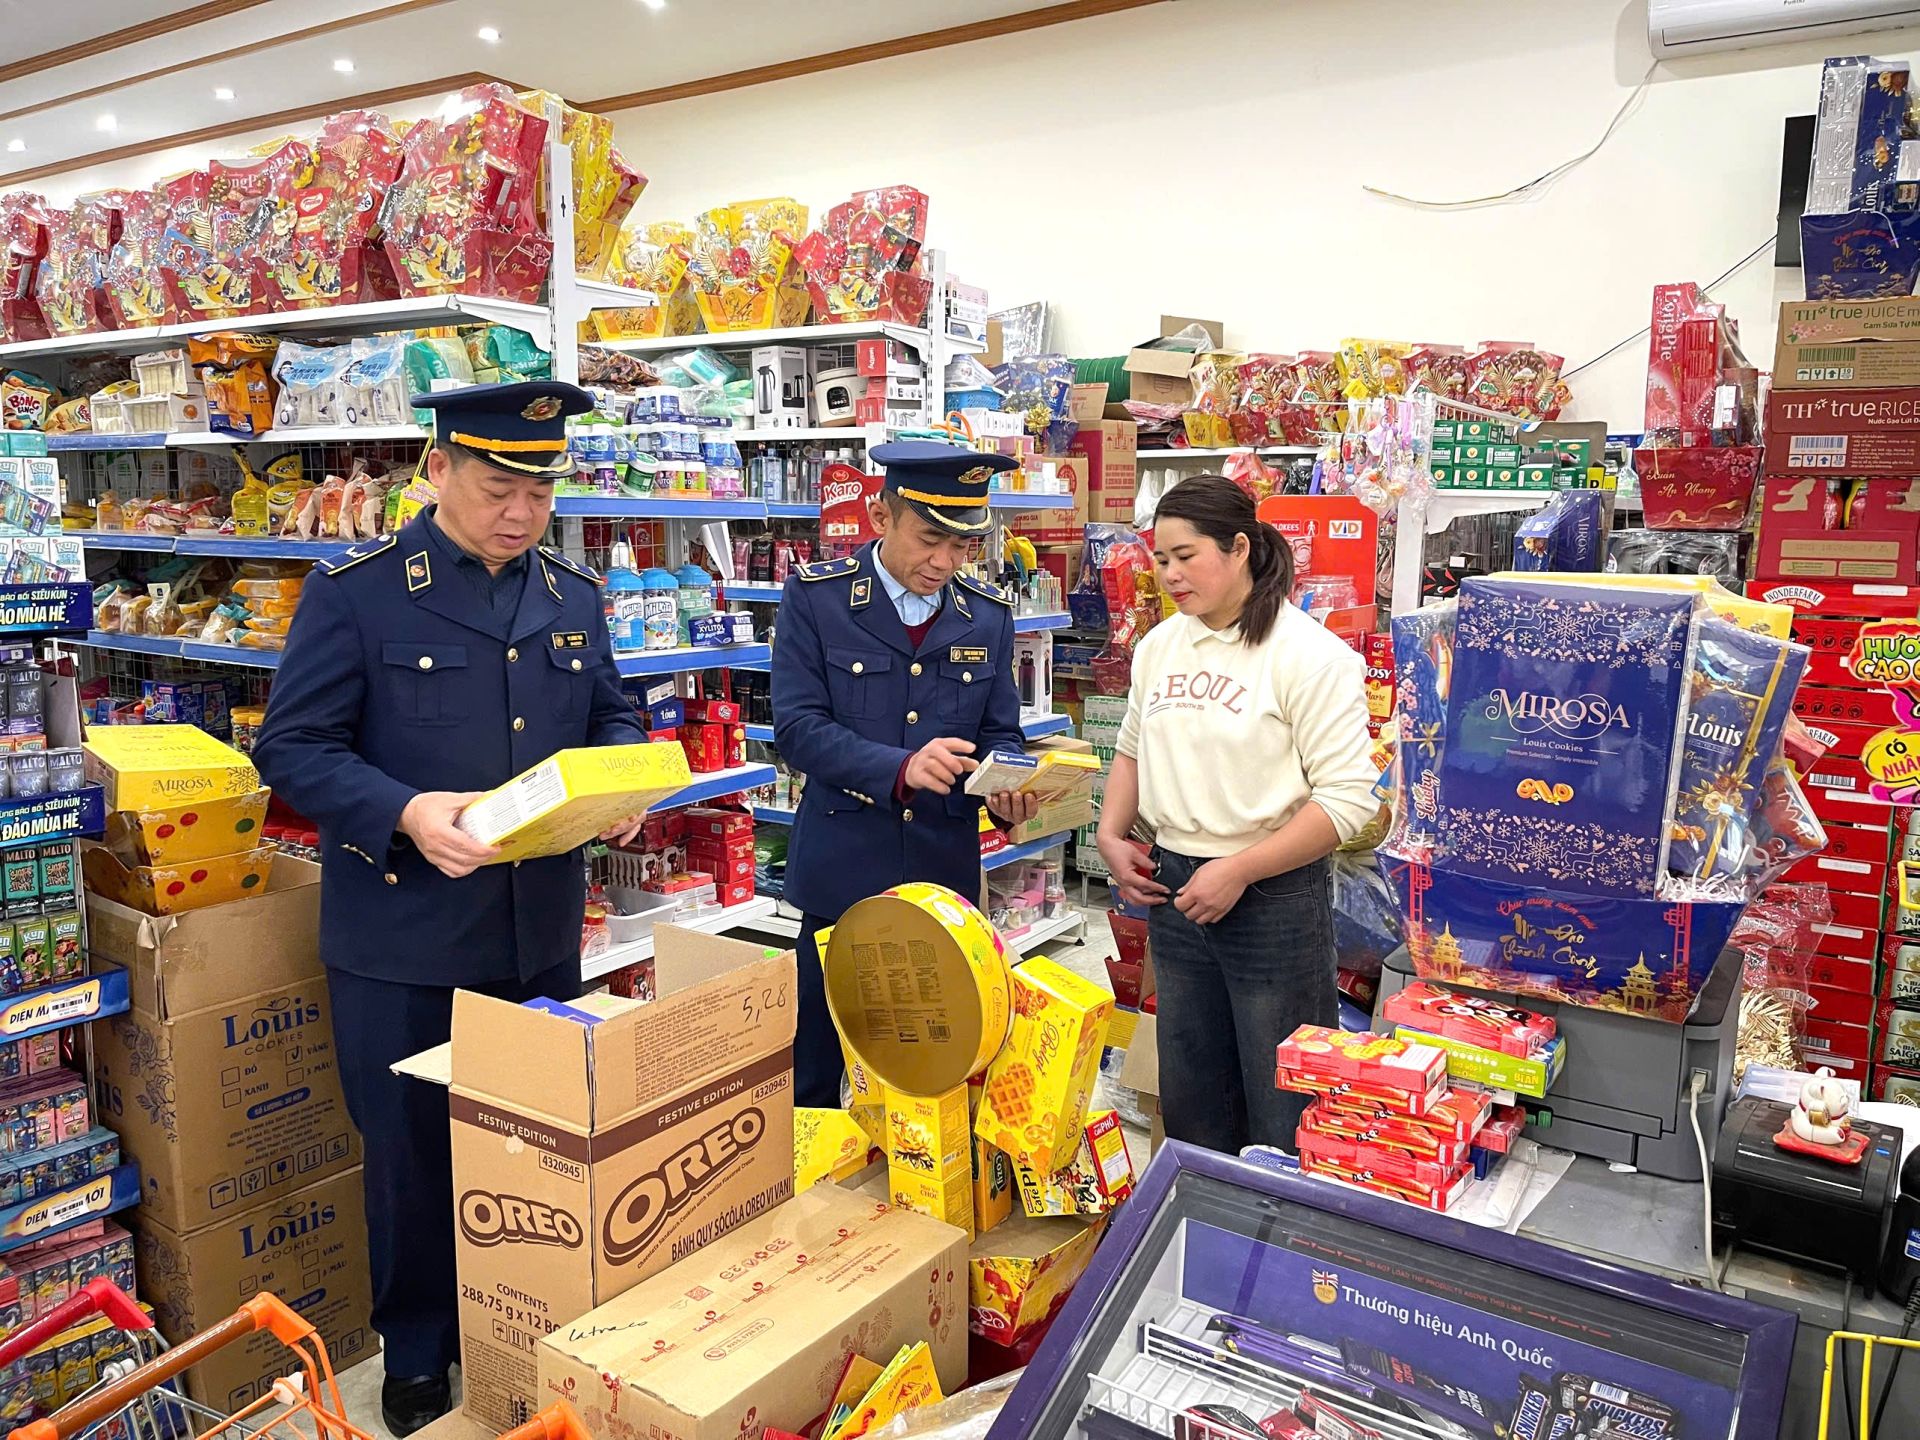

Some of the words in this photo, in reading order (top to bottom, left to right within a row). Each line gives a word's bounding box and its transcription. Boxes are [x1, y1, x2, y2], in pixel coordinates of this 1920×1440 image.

[226, 176, 259, 190] ongP
[1794, 309, 1817, 321] TH
[1830, 306, 1863, 320] true
[1865, 305, 1906, 319] JUICE
[1782, 403, 1812, 419] TH
[1831, 399, 1876, 417] true
[824, 481, 863, 502] Karo
[1766, 587, 1820, 603] WONDERFARM
[1856, 658, 1911, 682] CAO
[1486, 687, 1632, 738] MIROSA
[1686, 712, 1744, 747] Louis
[1523, 737, 1547, 748] Louis
[1548, 742, 1584, 753] Cookies
[1885, 738, 1908, 756] CÓ
[13, 756, 46, 772] MALTO
[50, 753, 83, 769] MALTO
[152, 776, 214, 797] MIROSA
[1411, 769, 1441, 822] Lucky
[33, 812, 62, 835] MÙA
[42, 843, 71, 858] MALTO
[742, 982, 788, 1023] 5,28
[221, 997, 321, 1049] Louis
[244, 1031, 304, 1056] COOKIES
[754, 1075, 787, 1099] 4320945
[658, 1096, 702, 1127] FESTIVE
[703, 1078, 744, 1106] EDITION
[478, 1112, 516, 1133] FESTIVE
[517, 1125, 557, 1148] EDITION
[542, 1155, 580, 1178] 4320945
[603, 1107, 766, 1268] OREO
[1033, 1189, 1044, 1214] Café
[459, 1189, 583, 1249] OREO
[671, 1234, 695, 1262] BÁNH
[696, 1221, 713, 1248] QUY
[714, 1204, 745, 1232] SÔCÔLA
[745, 1194, 766, 1217] OREO
[773, 1176, 791, 1200] VANI
[679, 1205, 697, 1224] Cookies
[239, 1201, 336, 1258] Louis
[261, 1234, 320, 1264] COOKIES
[462, 1284, 503, 1312] 288,75
[506, 1305, 514, 1320] g
[516, 1310, 524, 1322] x
[527, 1311, 541, 1330] 12
[496, 1283, 549, 1313] CONTENTS
[1342, 1285, 1410, 1325] Thương
[1413, 1309, 1454, 1336] hiệu
[1457, 1325, 1497, 1351] Anh
[1501, 1338, 1554, 1370] Quốc
[1586, 1399, 1668, 1434] SNICKERS
